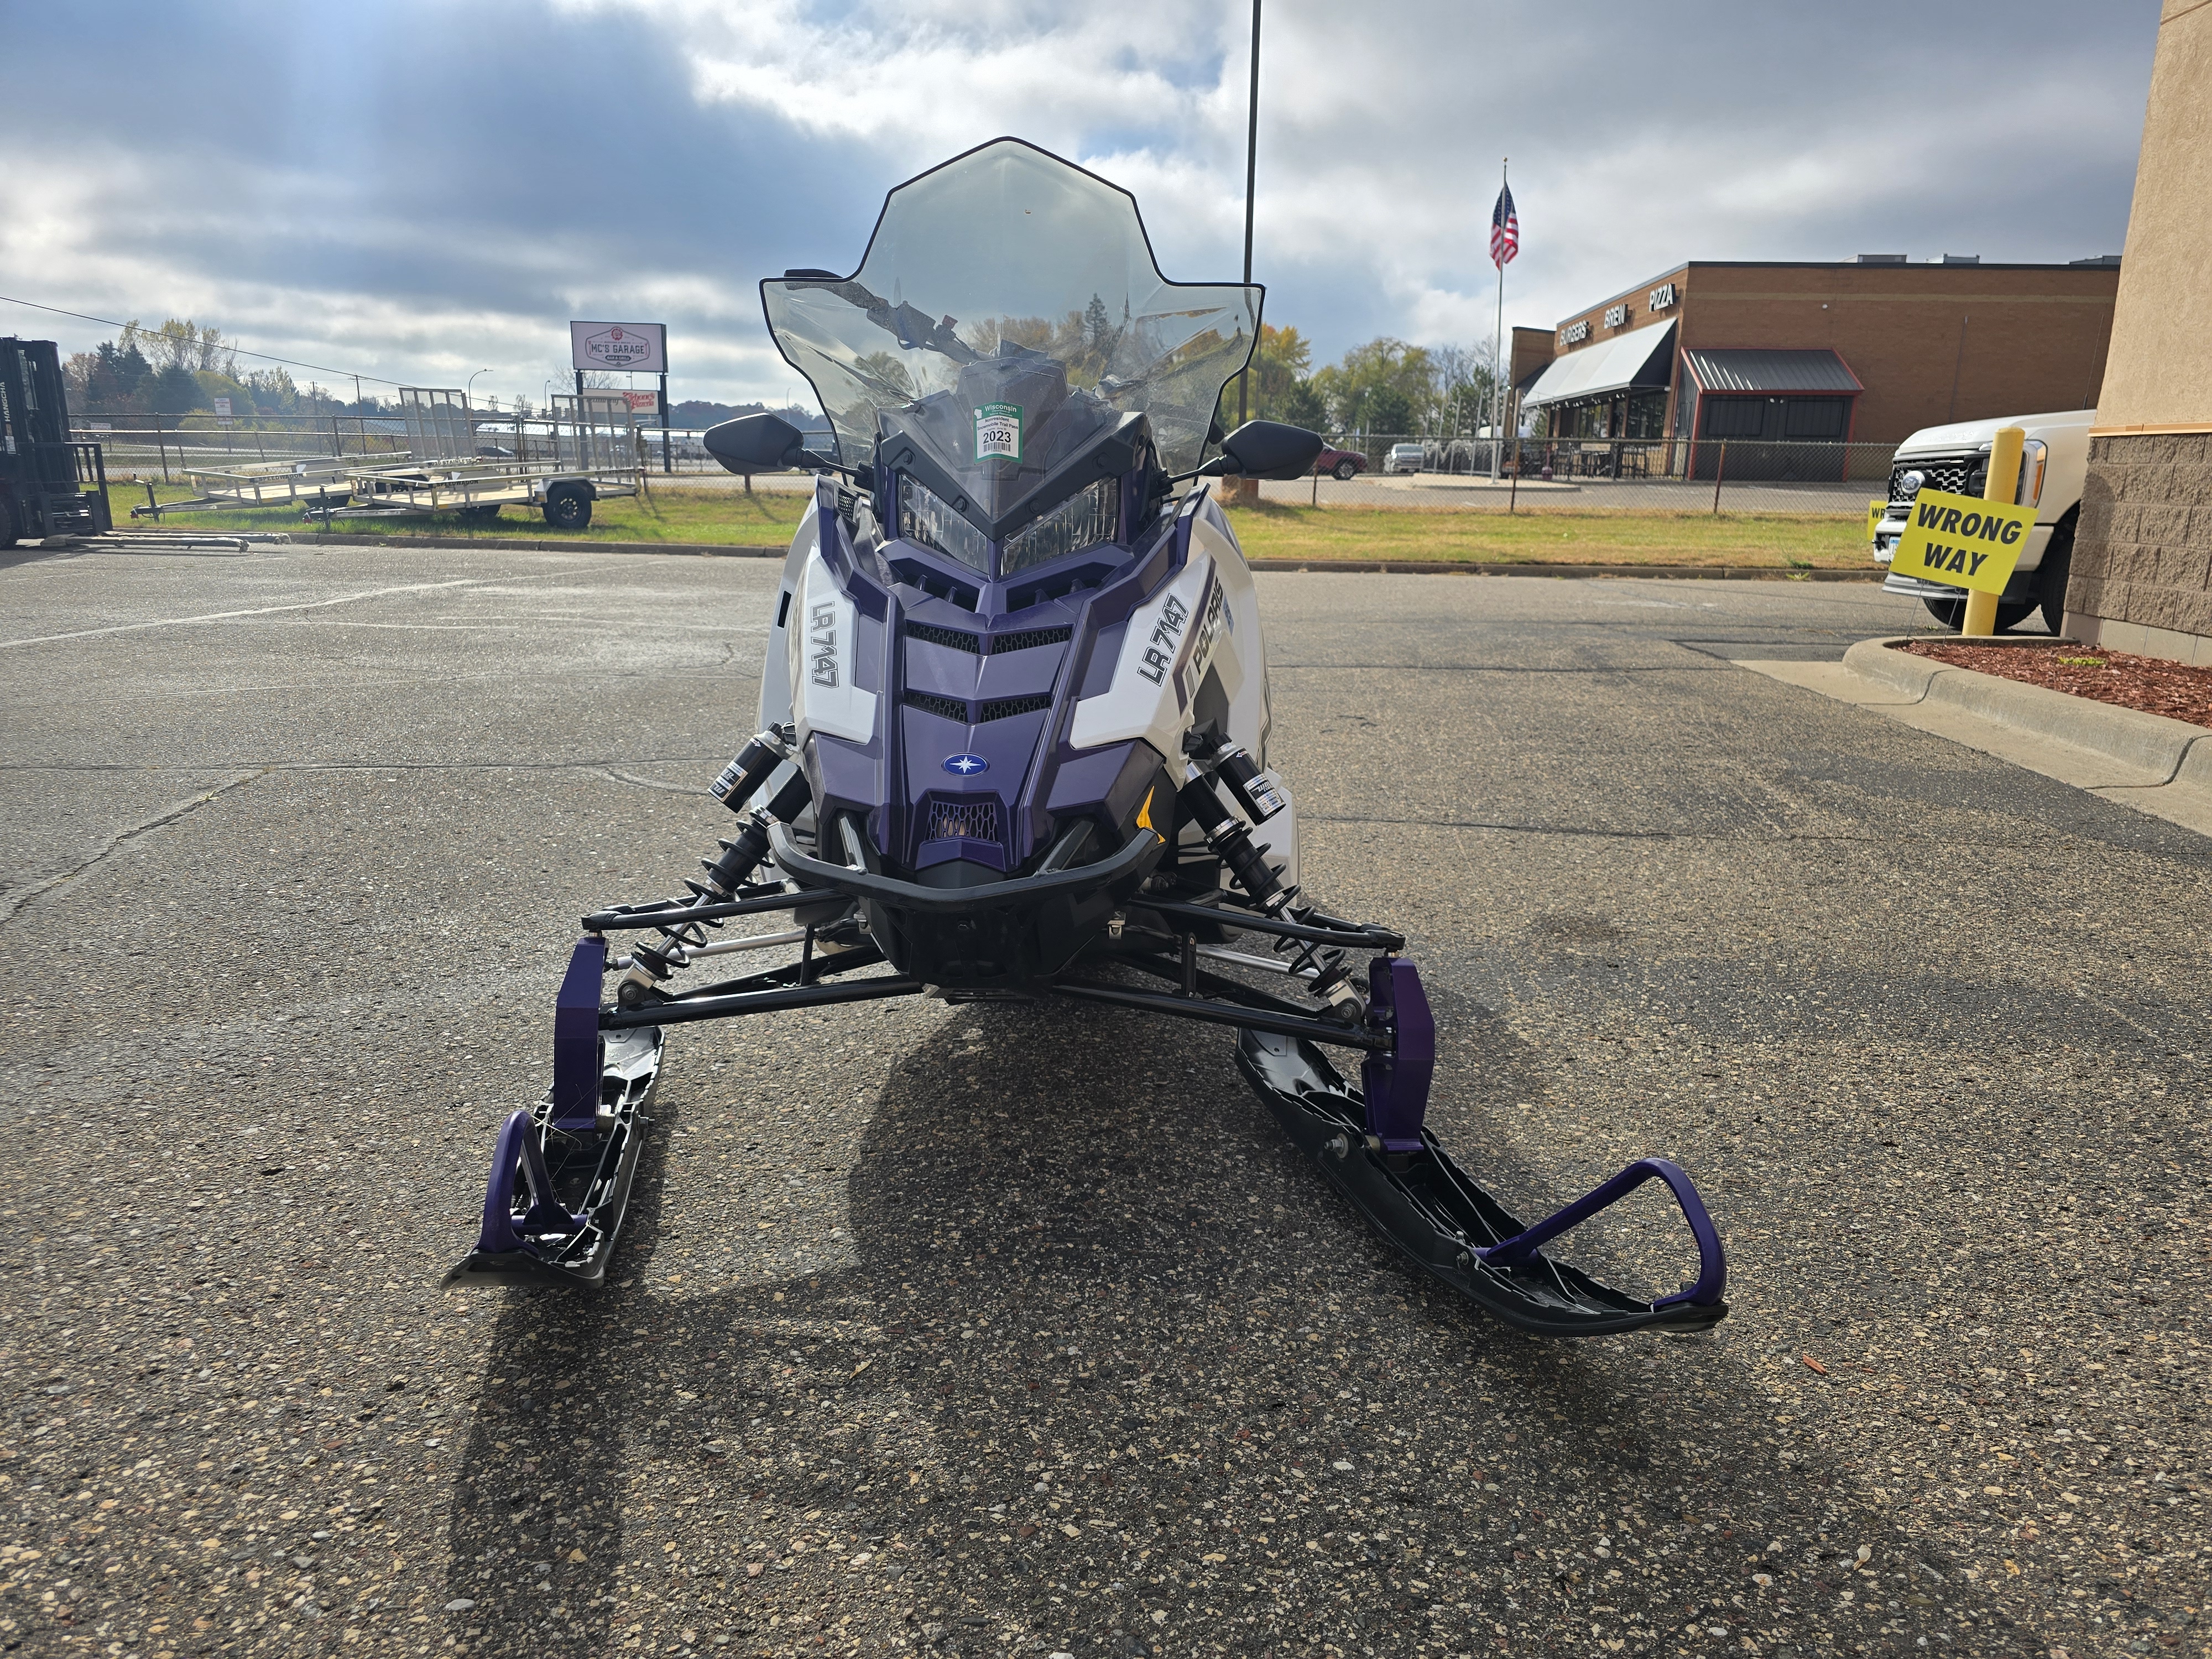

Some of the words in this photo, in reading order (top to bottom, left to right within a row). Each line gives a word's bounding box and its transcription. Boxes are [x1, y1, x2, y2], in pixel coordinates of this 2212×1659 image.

[1559, 320, 1589, 346] BURGERS
[1604, 303, 1627, 329] BREW
[1649, 283, 1675, 312] PIZZA
[591, 343, 609, 353] MC'S
[613, 345, 645, 354] GARAGE
[0, 382, 11, 422] HANGCHA
[985, 404, 1017, 413] Wisconsin
[977, 422, 999, 431] Snowmobile
[983, 431, 1011, 444] 2023
[259, 473, 304, 481] SPEEDWAGON
[1917, 503, 2022, 545] WRONG
[1924, 542, 1989, 576] WAY
[811, 601, 835, 633] LR
[1150, 592, 1189, 654] 7147
[1192, 575, 1224, 676] POLARIS
[811, 630, 839, 688] 7147
[1137, 646, 1171, 687] LR
